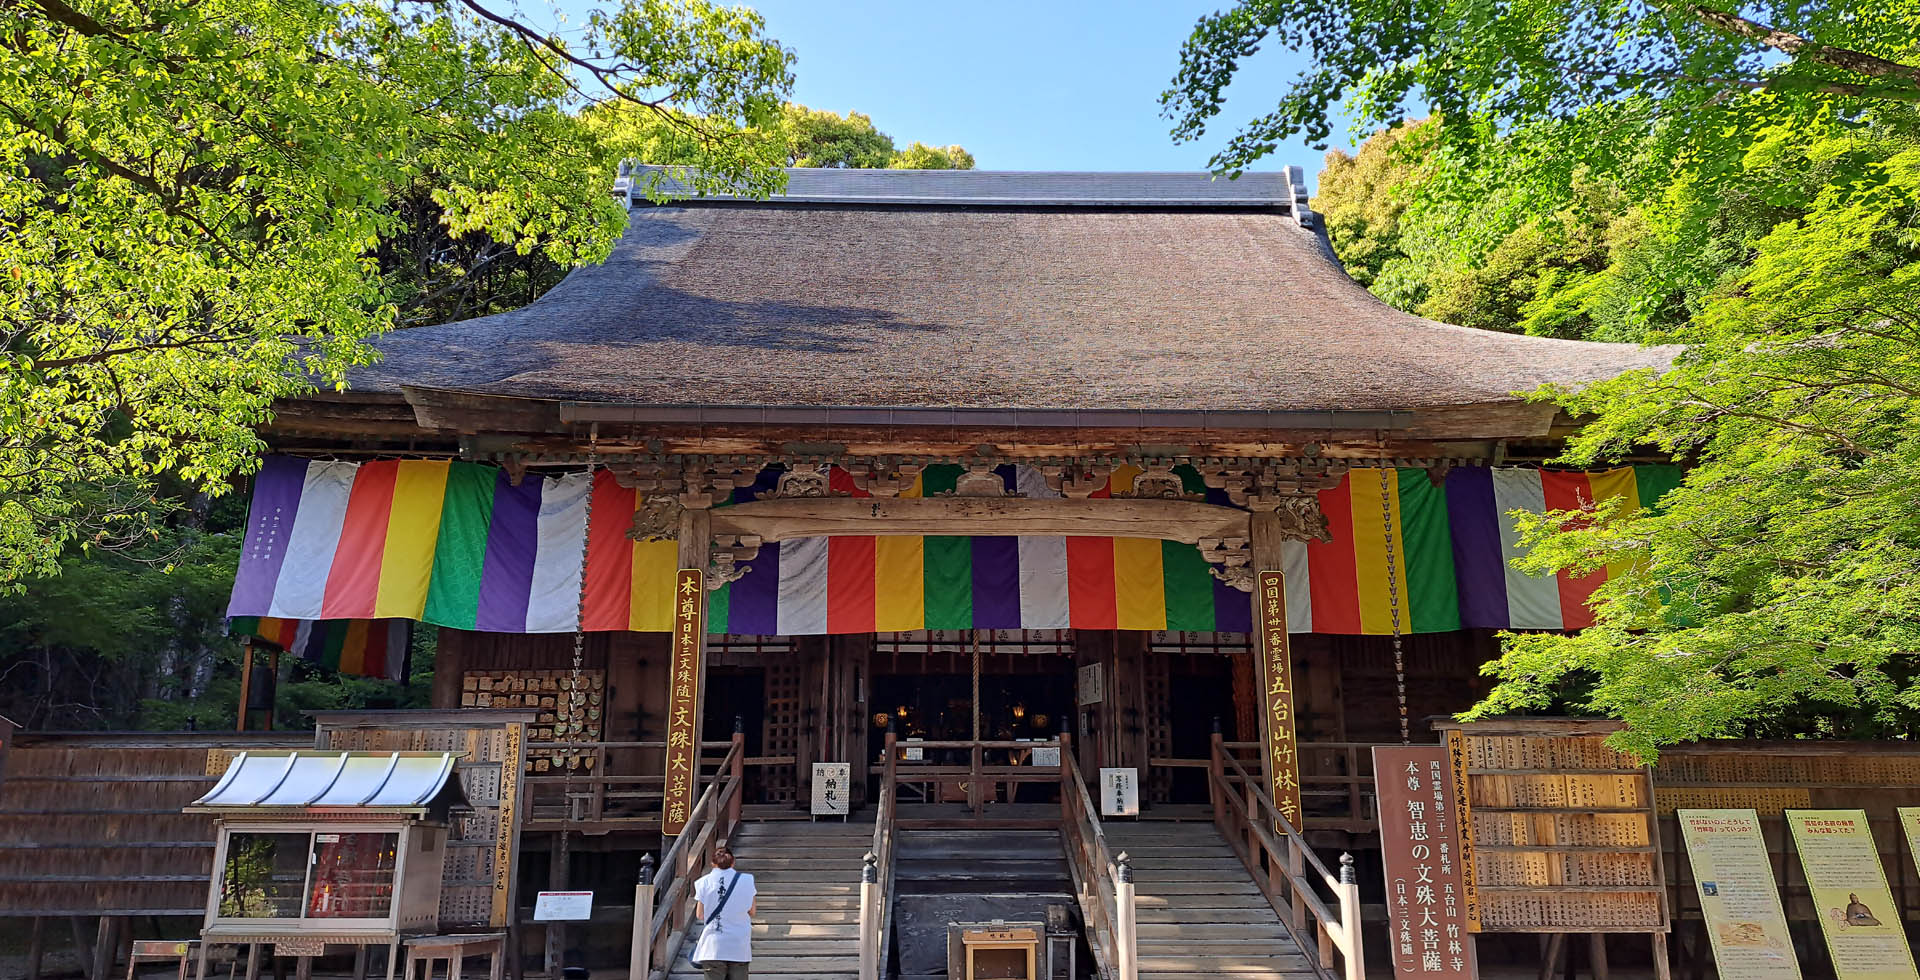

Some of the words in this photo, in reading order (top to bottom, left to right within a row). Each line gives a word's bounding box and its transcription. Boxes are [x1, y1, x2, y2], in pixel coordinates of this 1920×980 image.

[1404, 761, 1421, 791] 本尊
[1430, 761, 1452, 875] 四国霊場第三十一番札所
[1406, 800, 1443, 972] 智恵の文殊大菩薩
[1444, 883, 1457, 918] 五台山
[1446, 924, 1464, 972] 竹林寺
